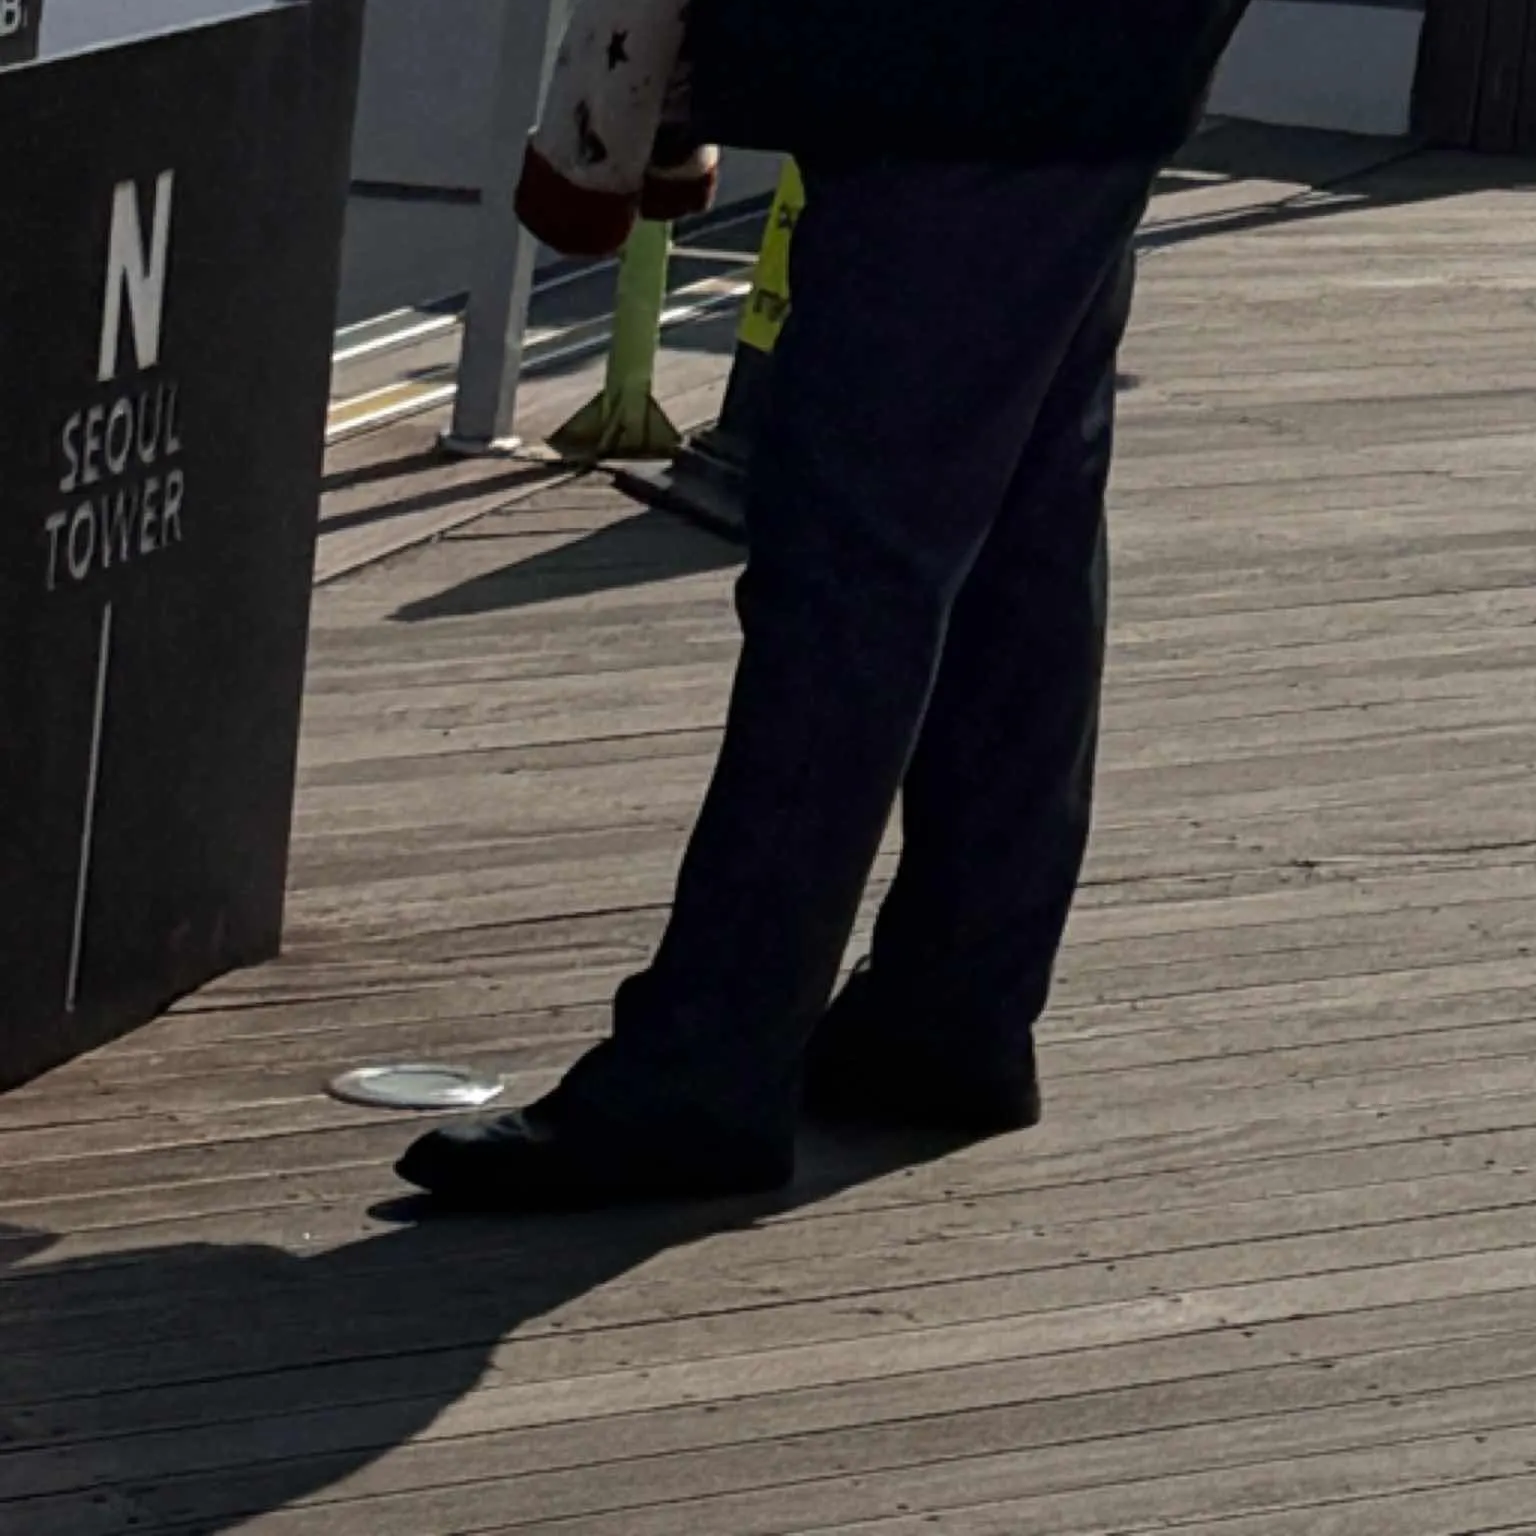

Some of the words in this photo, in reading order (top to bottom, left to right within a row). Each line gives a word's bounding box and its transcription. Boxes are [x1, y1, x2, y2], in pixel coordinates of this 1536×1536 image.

[96, 168, 176, 382] N
[59, 382, 184, 494] SEOUL
[45, 469, 185, 592] TOWER
